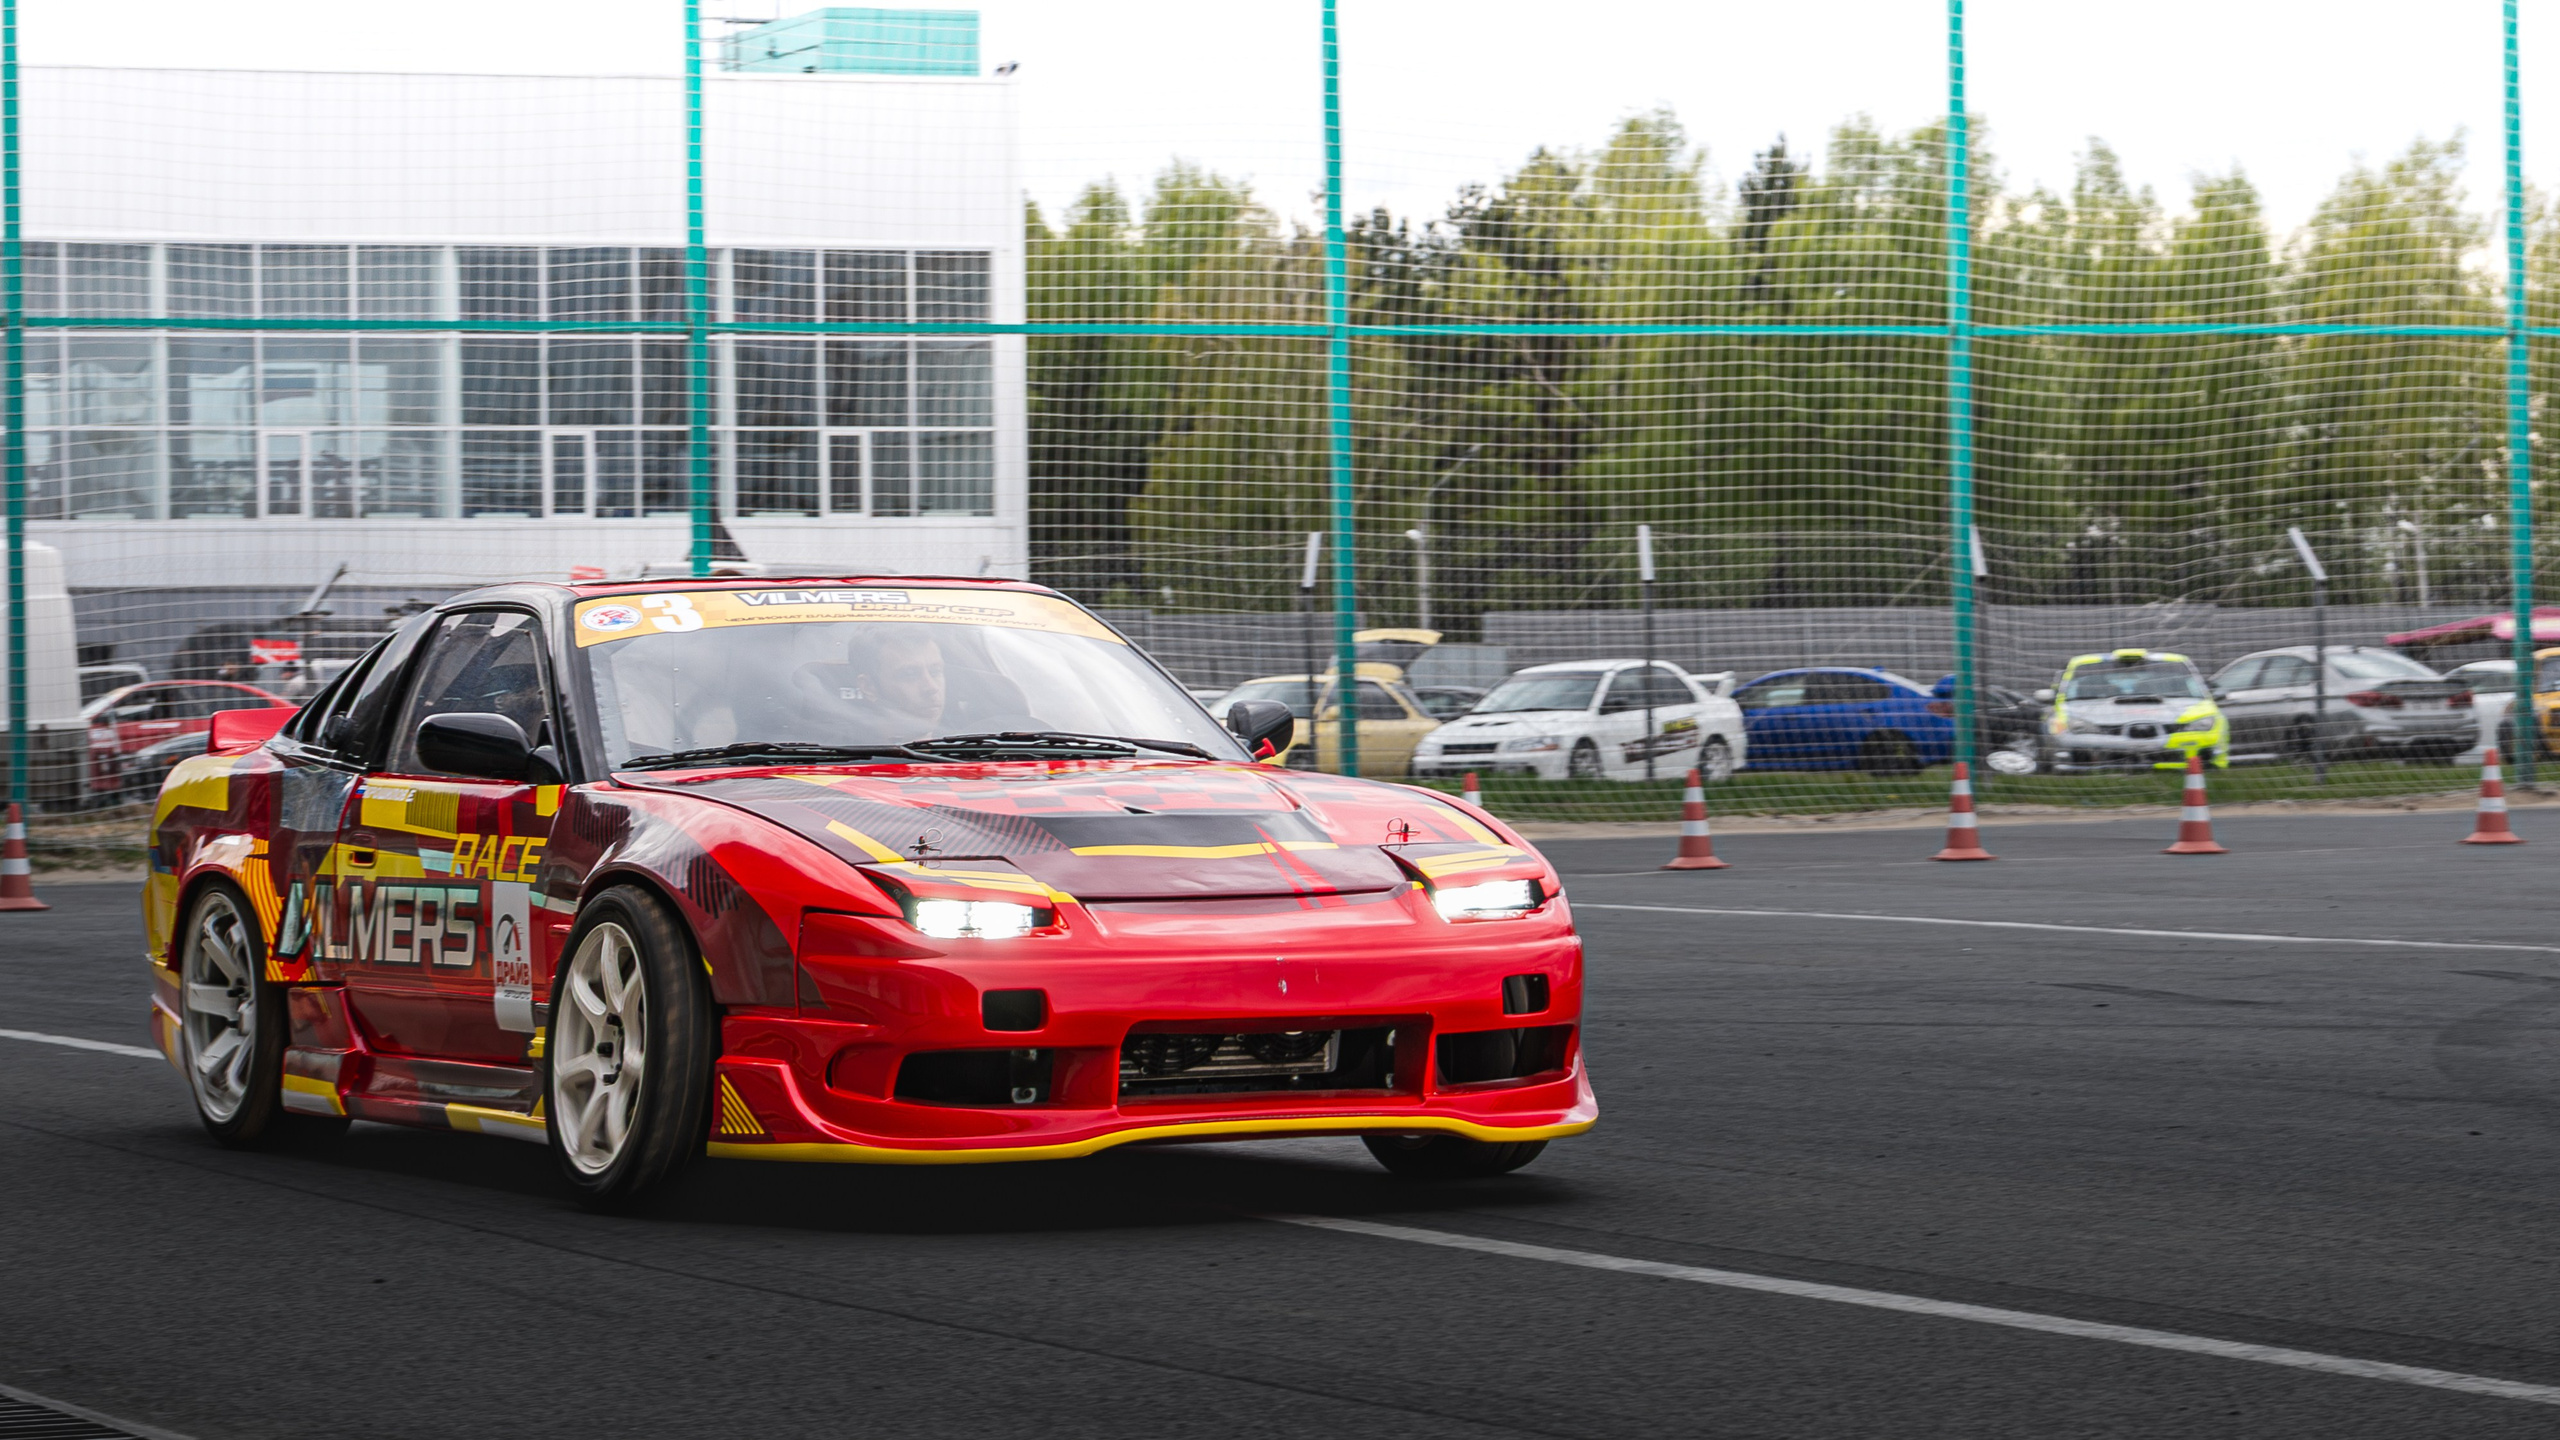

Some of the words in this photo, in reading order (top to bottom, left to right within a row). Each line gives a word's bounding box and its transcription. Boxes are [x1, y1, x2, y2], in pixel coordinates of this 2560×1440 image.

[641, 593, 704, 632] 3
[734, 590, 910, 606] VILMERS
[851, 603, 946, 613] DRIFT
[949, 605, 1015, 617] CUP
[449, 833, 548, 883] RACE
[496, 957, 529, 987] ДРАЙВ
